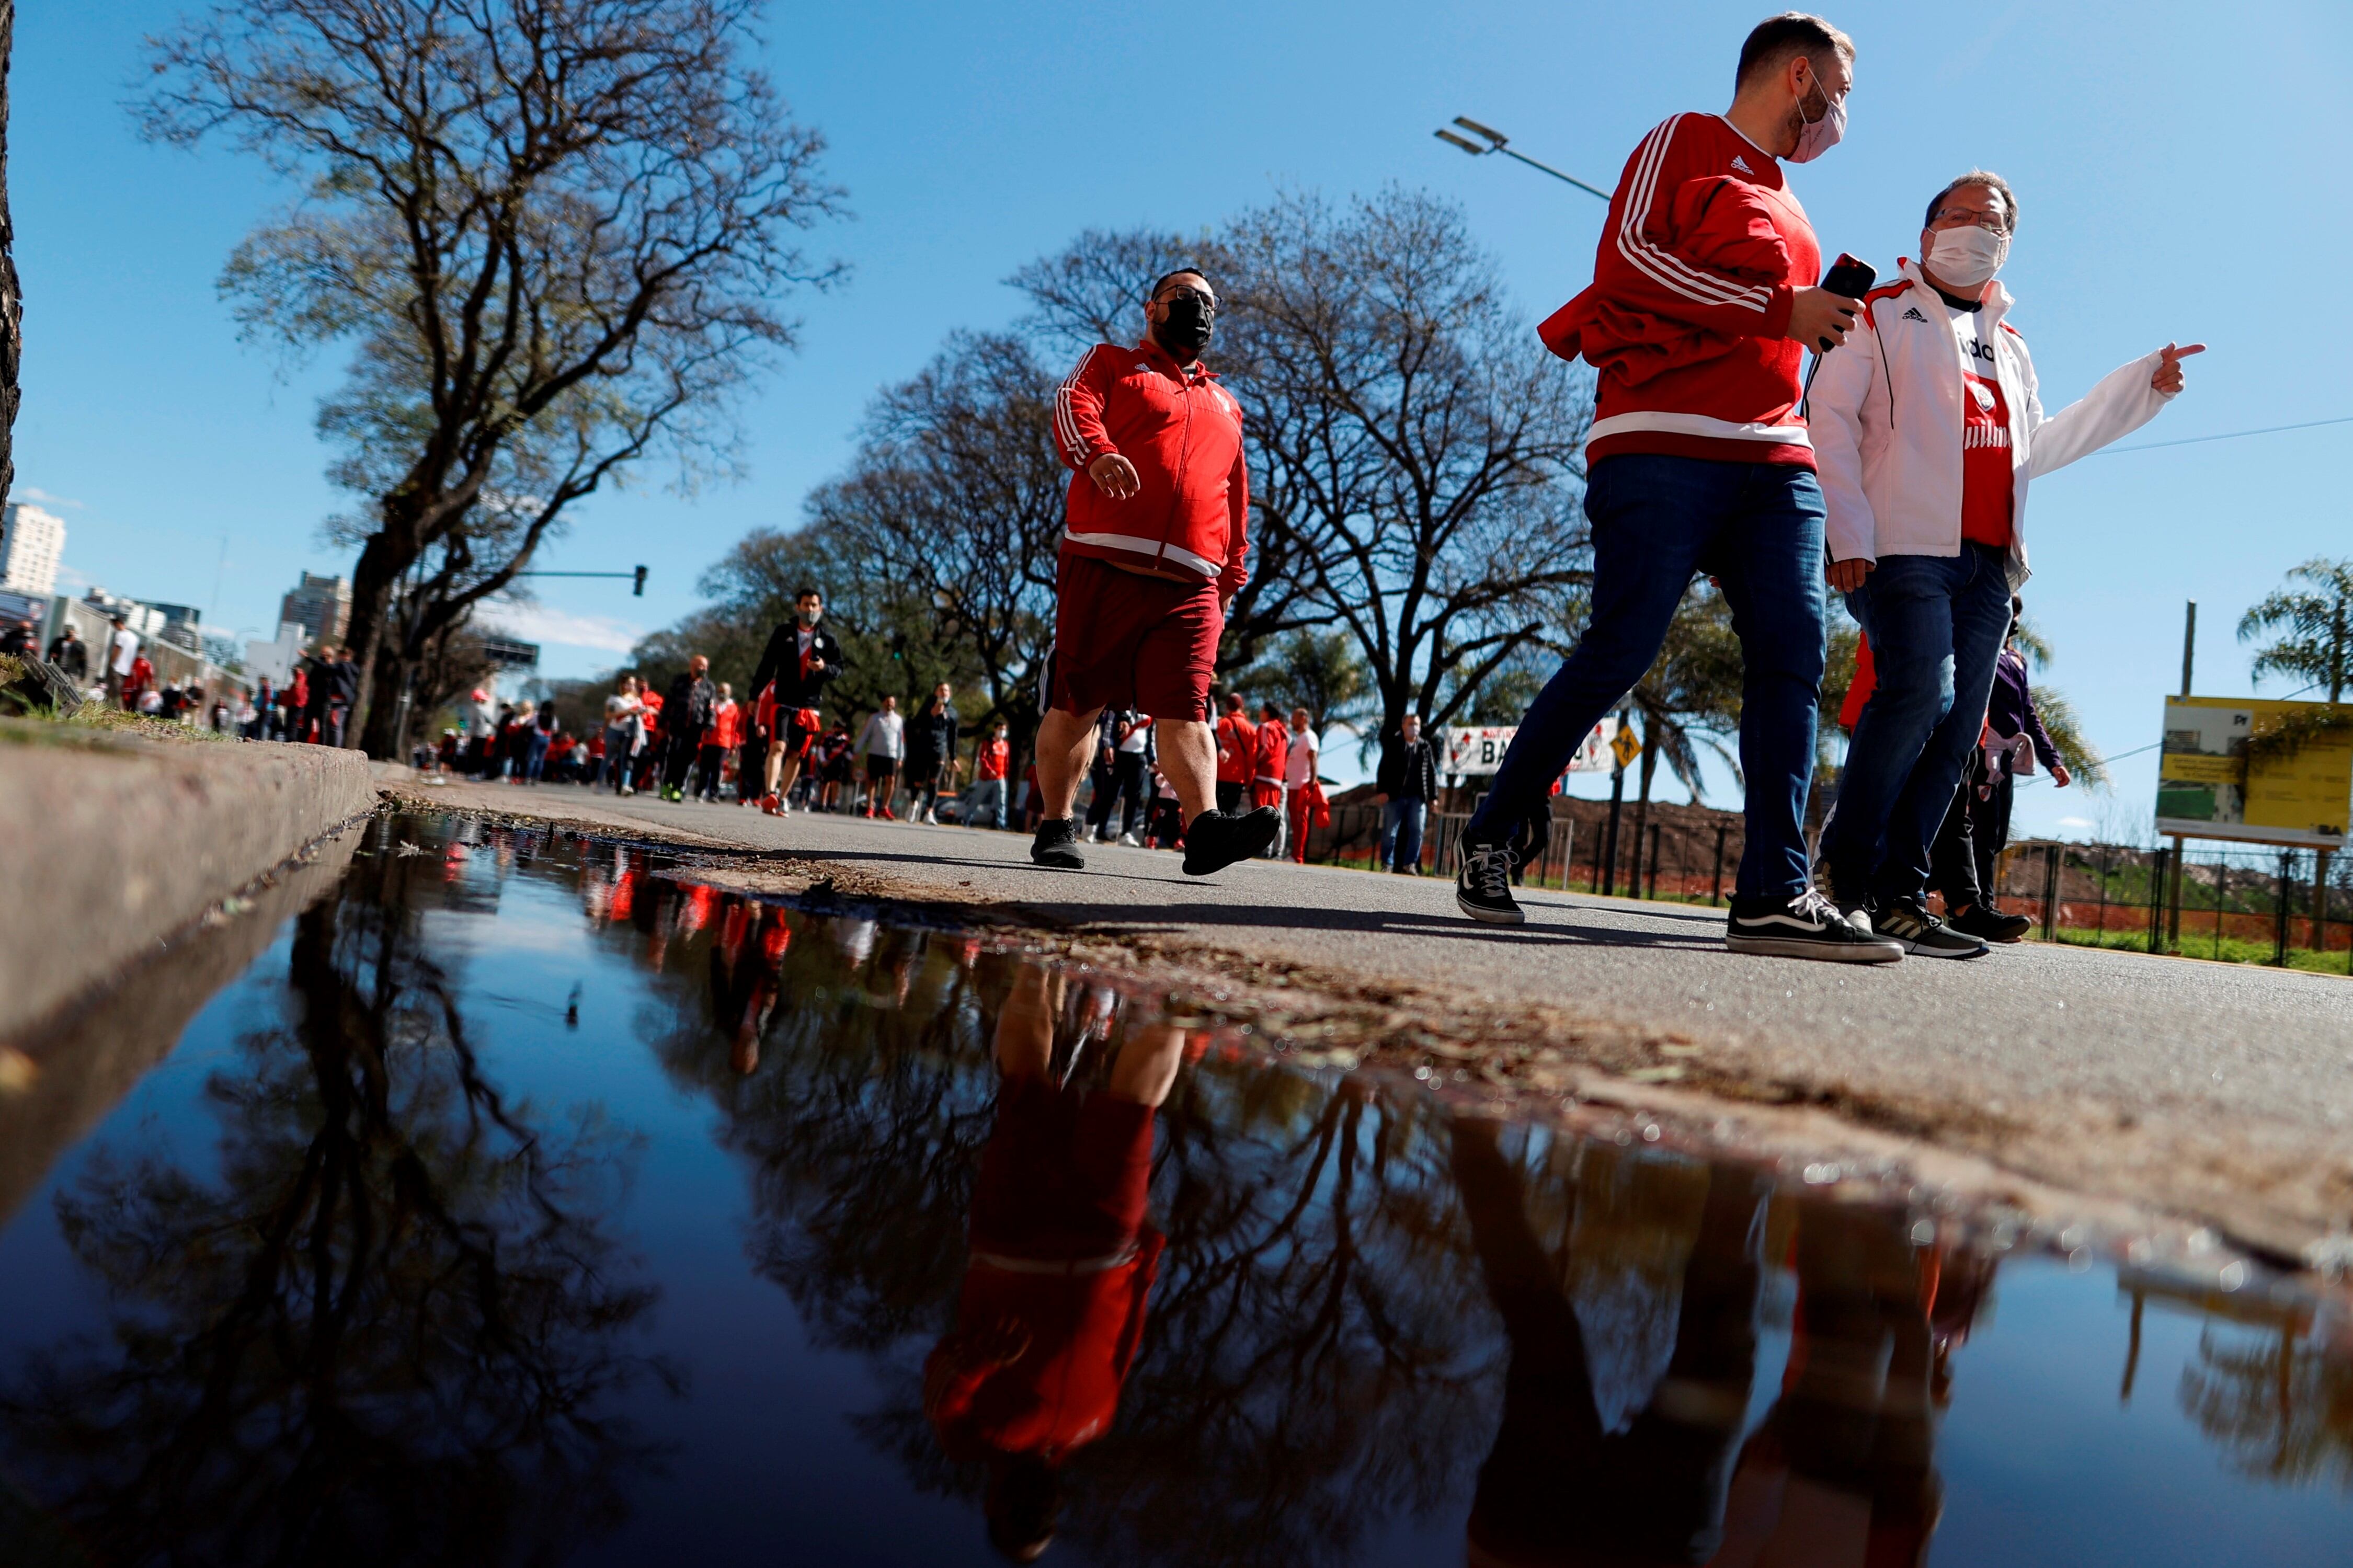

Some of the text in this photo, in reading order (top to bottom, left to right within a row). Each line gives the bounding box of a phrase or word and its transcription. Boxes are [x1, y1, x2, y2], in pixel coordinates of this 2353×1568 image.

[1730, 163, 1755, 176] adidas
[1902, 315, 1928, 323] adidas
[1964, 419, 2011, 450] uilm
